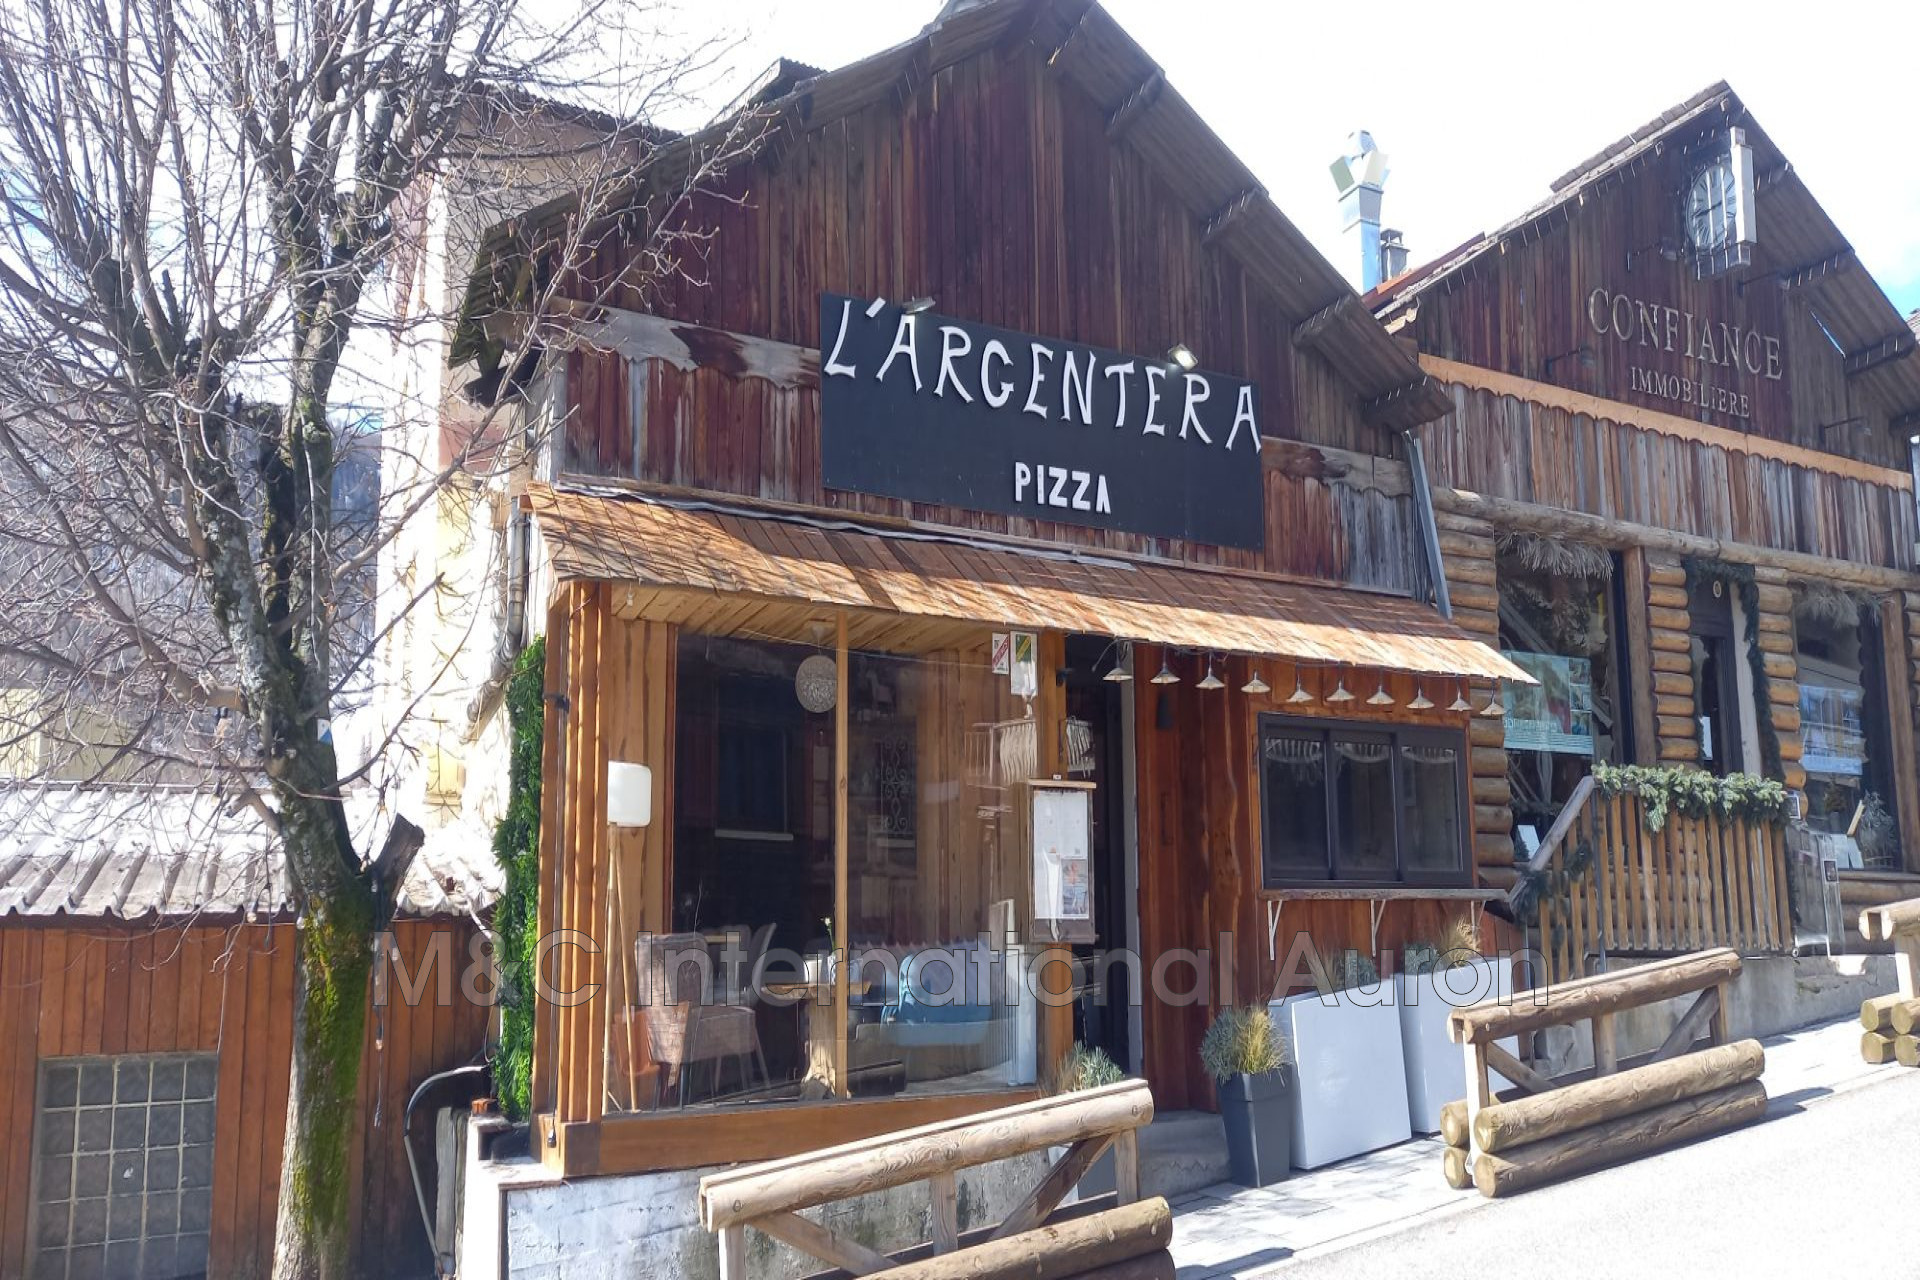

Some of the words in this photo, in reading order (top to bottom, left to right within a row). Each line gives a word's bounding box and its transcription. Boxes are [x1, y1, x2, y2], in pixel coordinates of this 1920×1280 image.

[823, 297, 1262, 453] L'ARGENTERA
[1588, 288, 1783, 381] CONFIANCE
[1015, 461, 1111, 514] PIZZA
